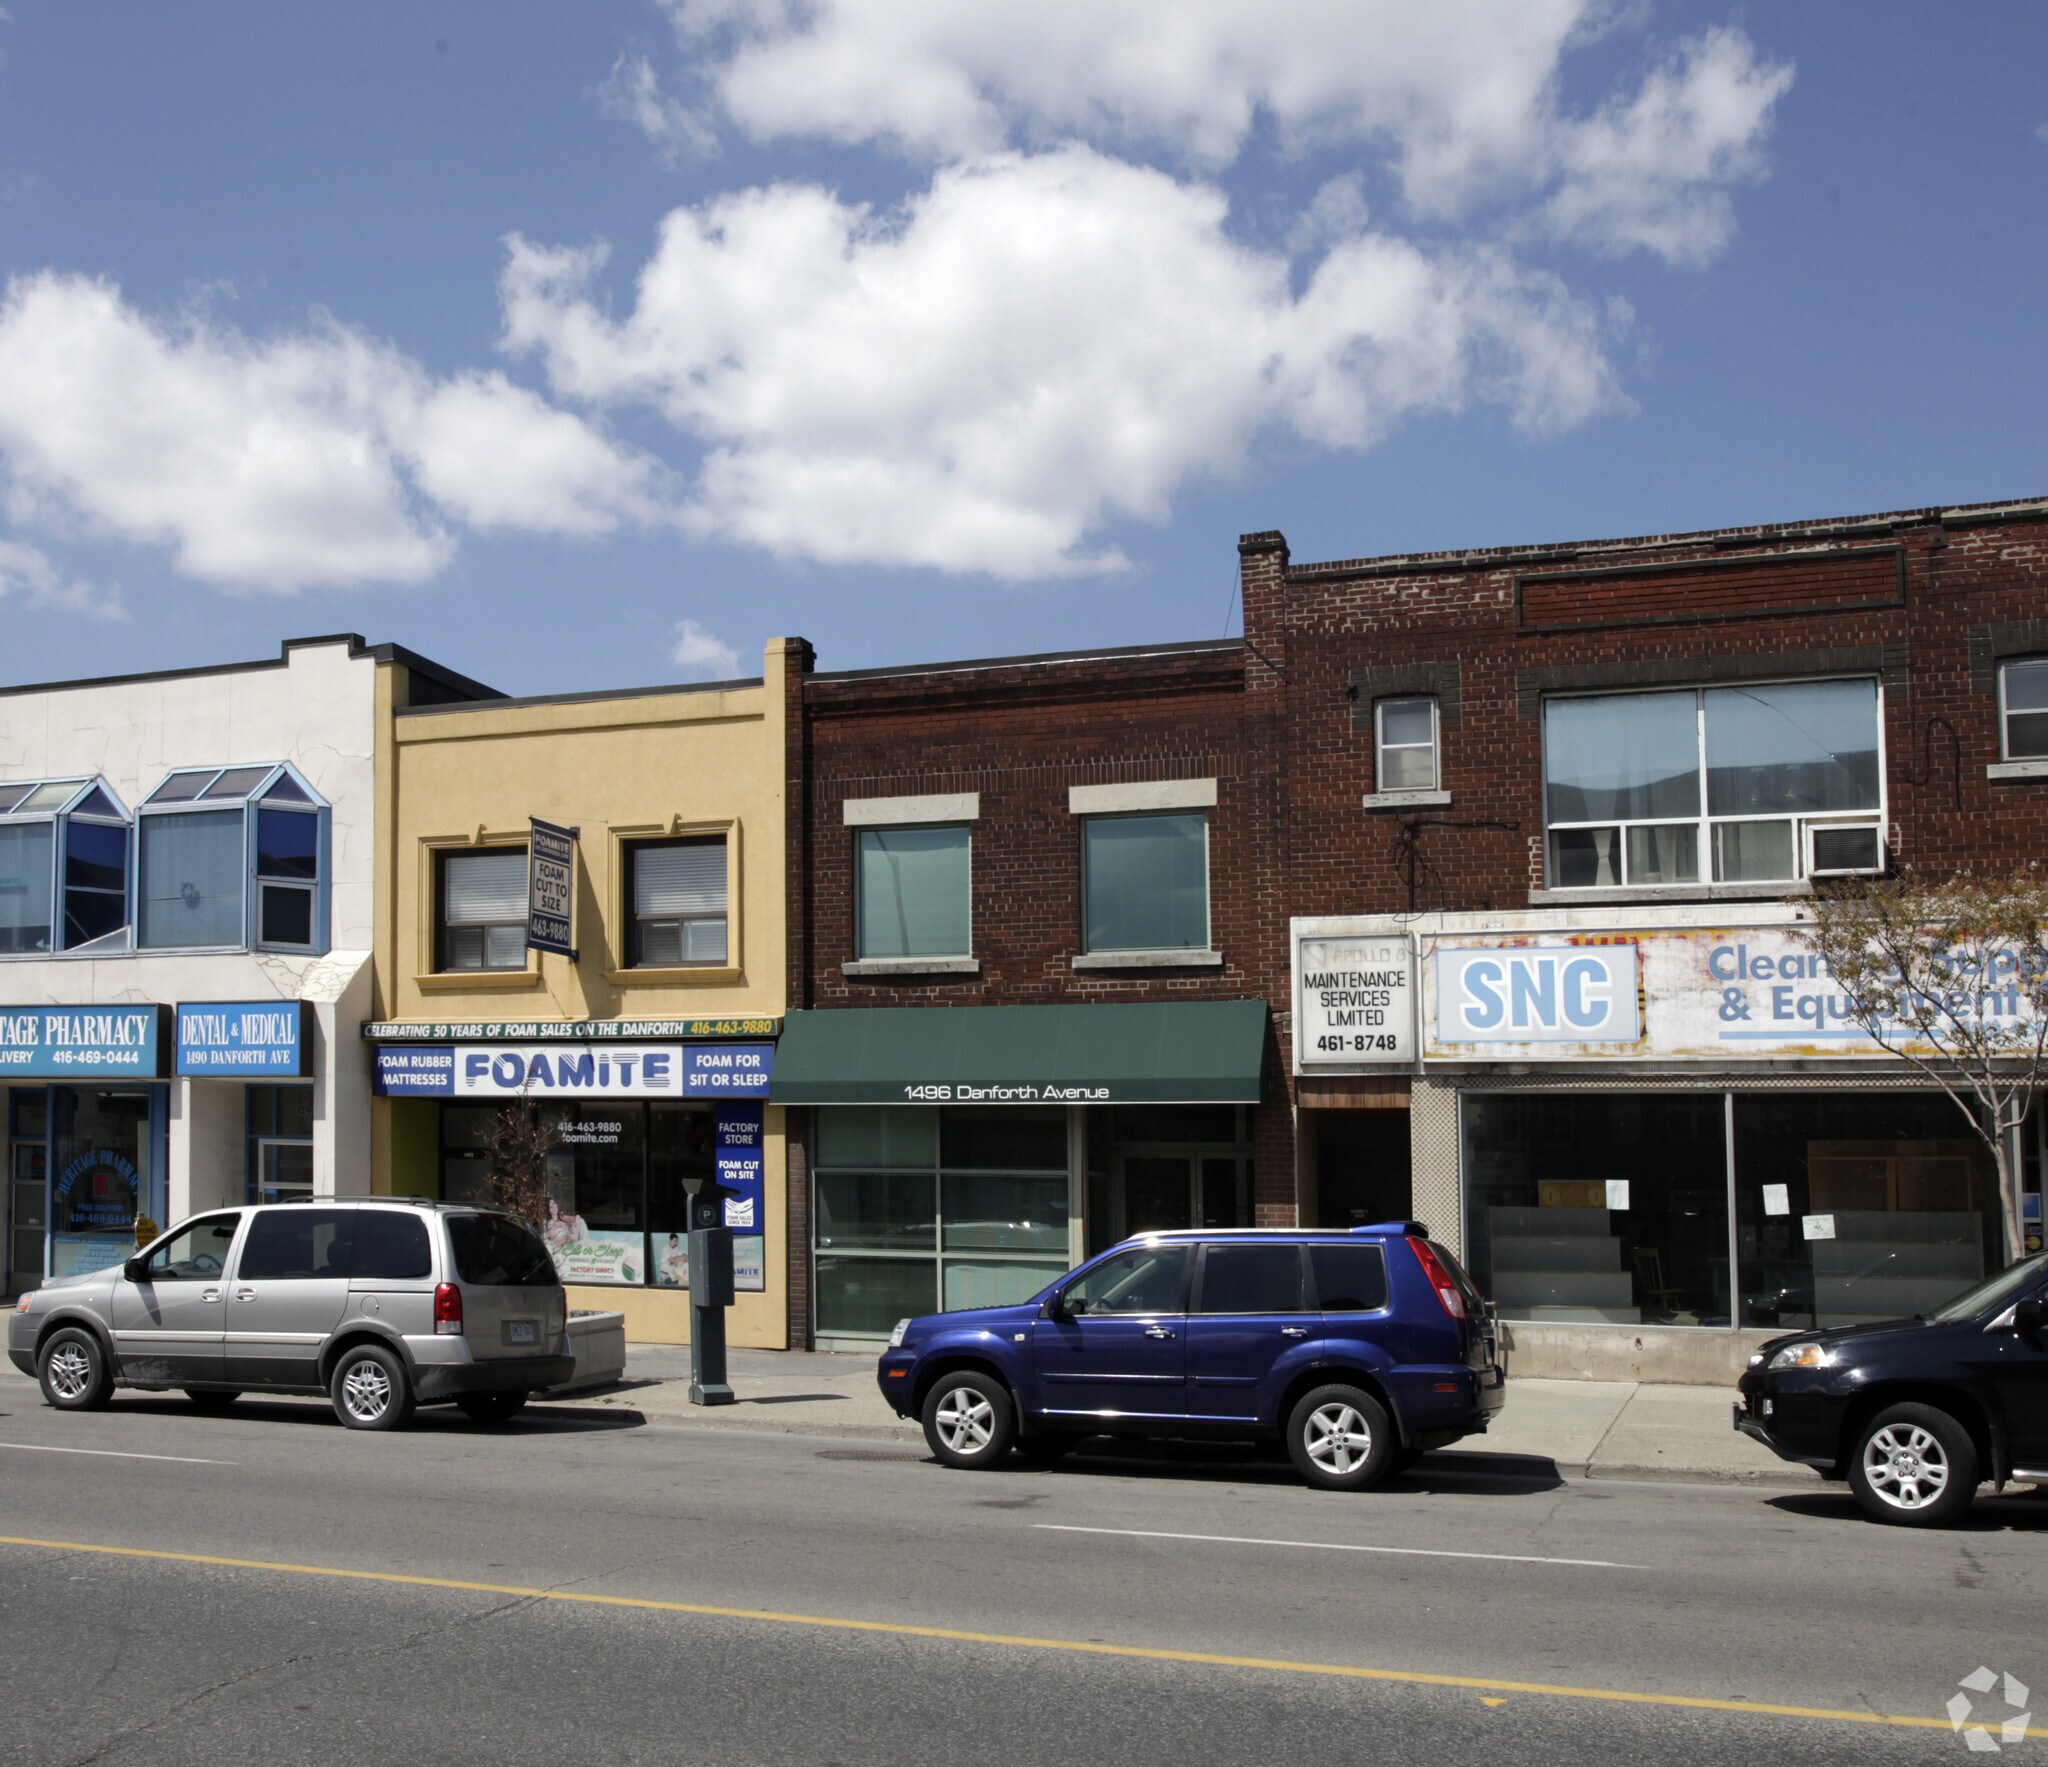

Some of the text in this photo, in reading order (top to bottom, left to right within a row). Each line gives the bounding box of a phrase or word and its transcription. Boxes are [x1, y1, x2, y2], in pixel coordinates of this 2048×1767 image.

[535, 834, 570, 854] FOAMITE
[539, 863, 565, 882] FOAM
[536, 877, 567, 898] CUT TO
[541, 895, 561, 912] SIZE
[532, 918, 569, 942] 463-9880
[1304, 970, 1406, 989] MAINTENANCE
[1320, 989, 1391, 1008] SERVICES
[1461, 956, 1611, 1031] SNC
[1717, 986, 1753, 1022] &
[1772, 984, 2021, 1030] Equpment
[1327, 1009, 1384, 1027] LIMITED
[44, 1015, 149, 1046] PHARMACY
[181, 1013, 296, 1046] DENTAL & MEDICAL
[363, 1020, 772, 1038] CELEBRATING 50 YEARS OF FOAM SALES ON THE DANFORTH 416-463-9880
[1316, 1034, 1397, 1051] 461-8748
[52, 1050, 140, 1064] 416-469-0444
[185, 1050, 291, 1065] 1490 DANFORTH AVE
[377, 1056, 453, 1068] FOAM RUBBER
[696, 1055, 761, 1068] FOAM FOR
[465, 1053, 671, 1088] FOAMITE
[382, 1073, 448, 1086] MATTRESSES
[689, 1073, 768, 1087] SIT OR SLEEP
[904, 1084, 1110, 1100] 1496 Danforth Avenue
[557, 1121, 622, 1133] 416-463-9880
[718, 1122, 760, 1133] FACTORY
[561, 1132, 618, 1143] foamite.com
[725, 1134, 753, 1145] STORE
[57, 1149, 98, 1196] HERITAGE
[718, 1160, 760, 1170] FOAM CUT
[724, 1170, 755, 1180] ON SITE
[703, 1210, 711, 1218] P
